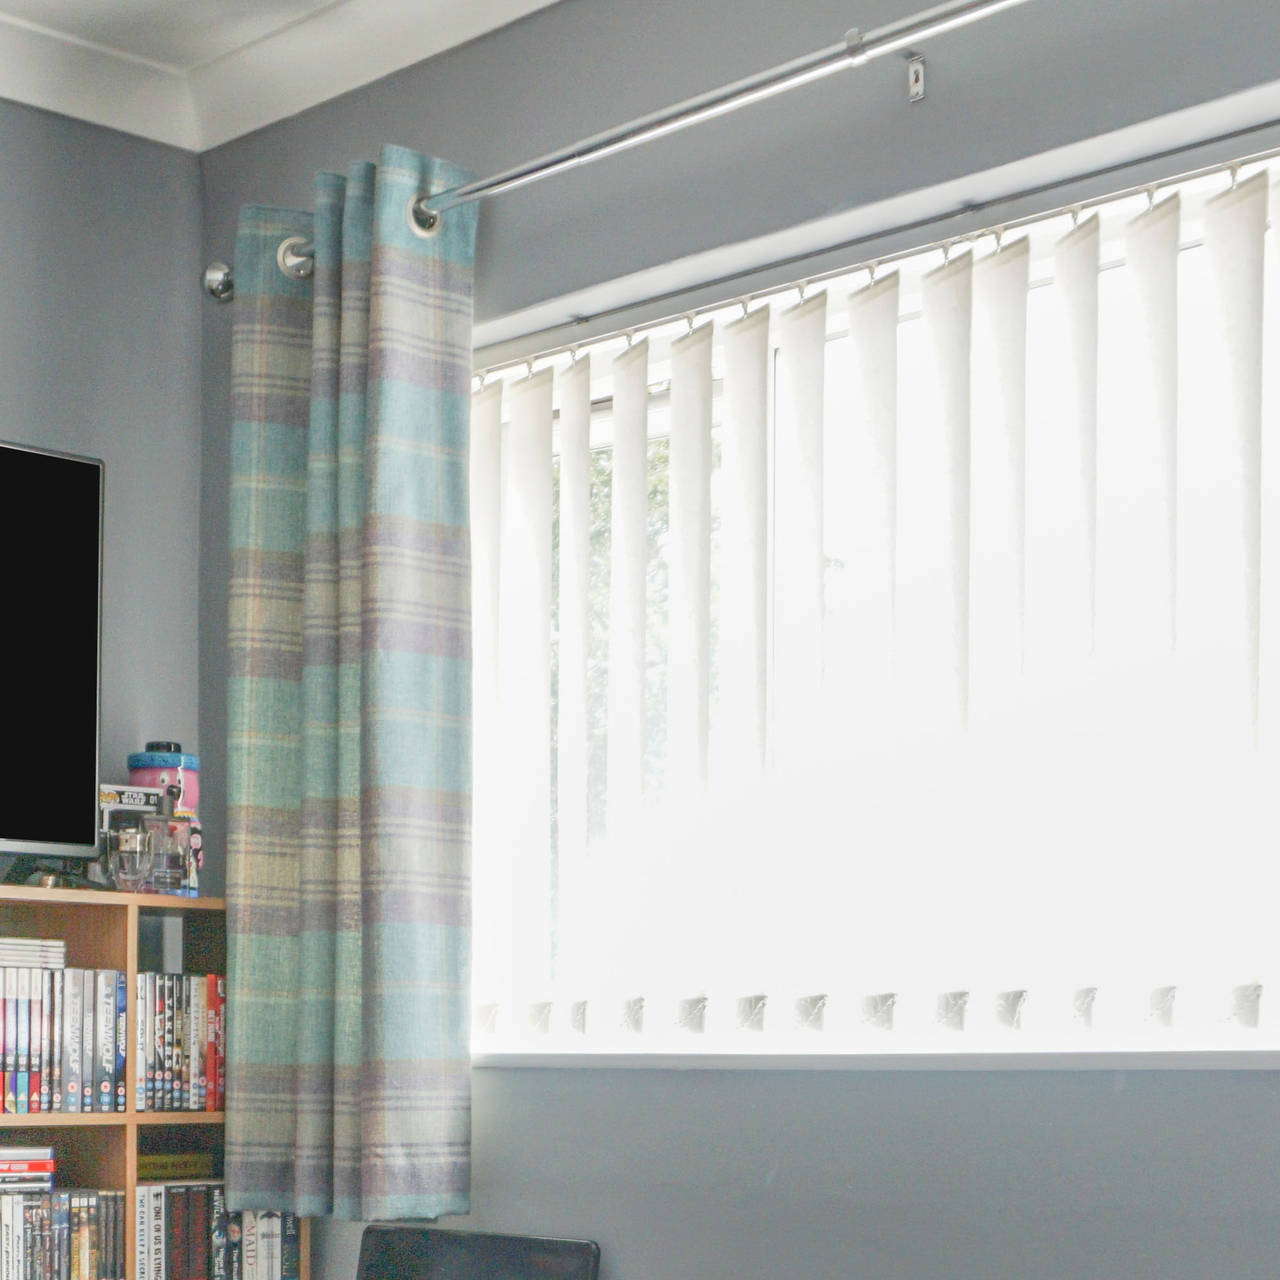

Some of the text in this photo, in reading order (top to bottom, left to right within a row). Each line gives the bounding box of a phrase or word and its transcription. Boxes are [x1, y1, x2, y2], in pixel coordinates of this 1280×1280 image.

[153, 1206, 162, 1223] ONE
[154, 1224, 162, 1234] OF
[154, 1235, 162, 1246] US
[246, 1225, 256, 1266] MAID
[154, 1248, 162, 1256] IS
[154, 1257, 162, 1280] LYING
